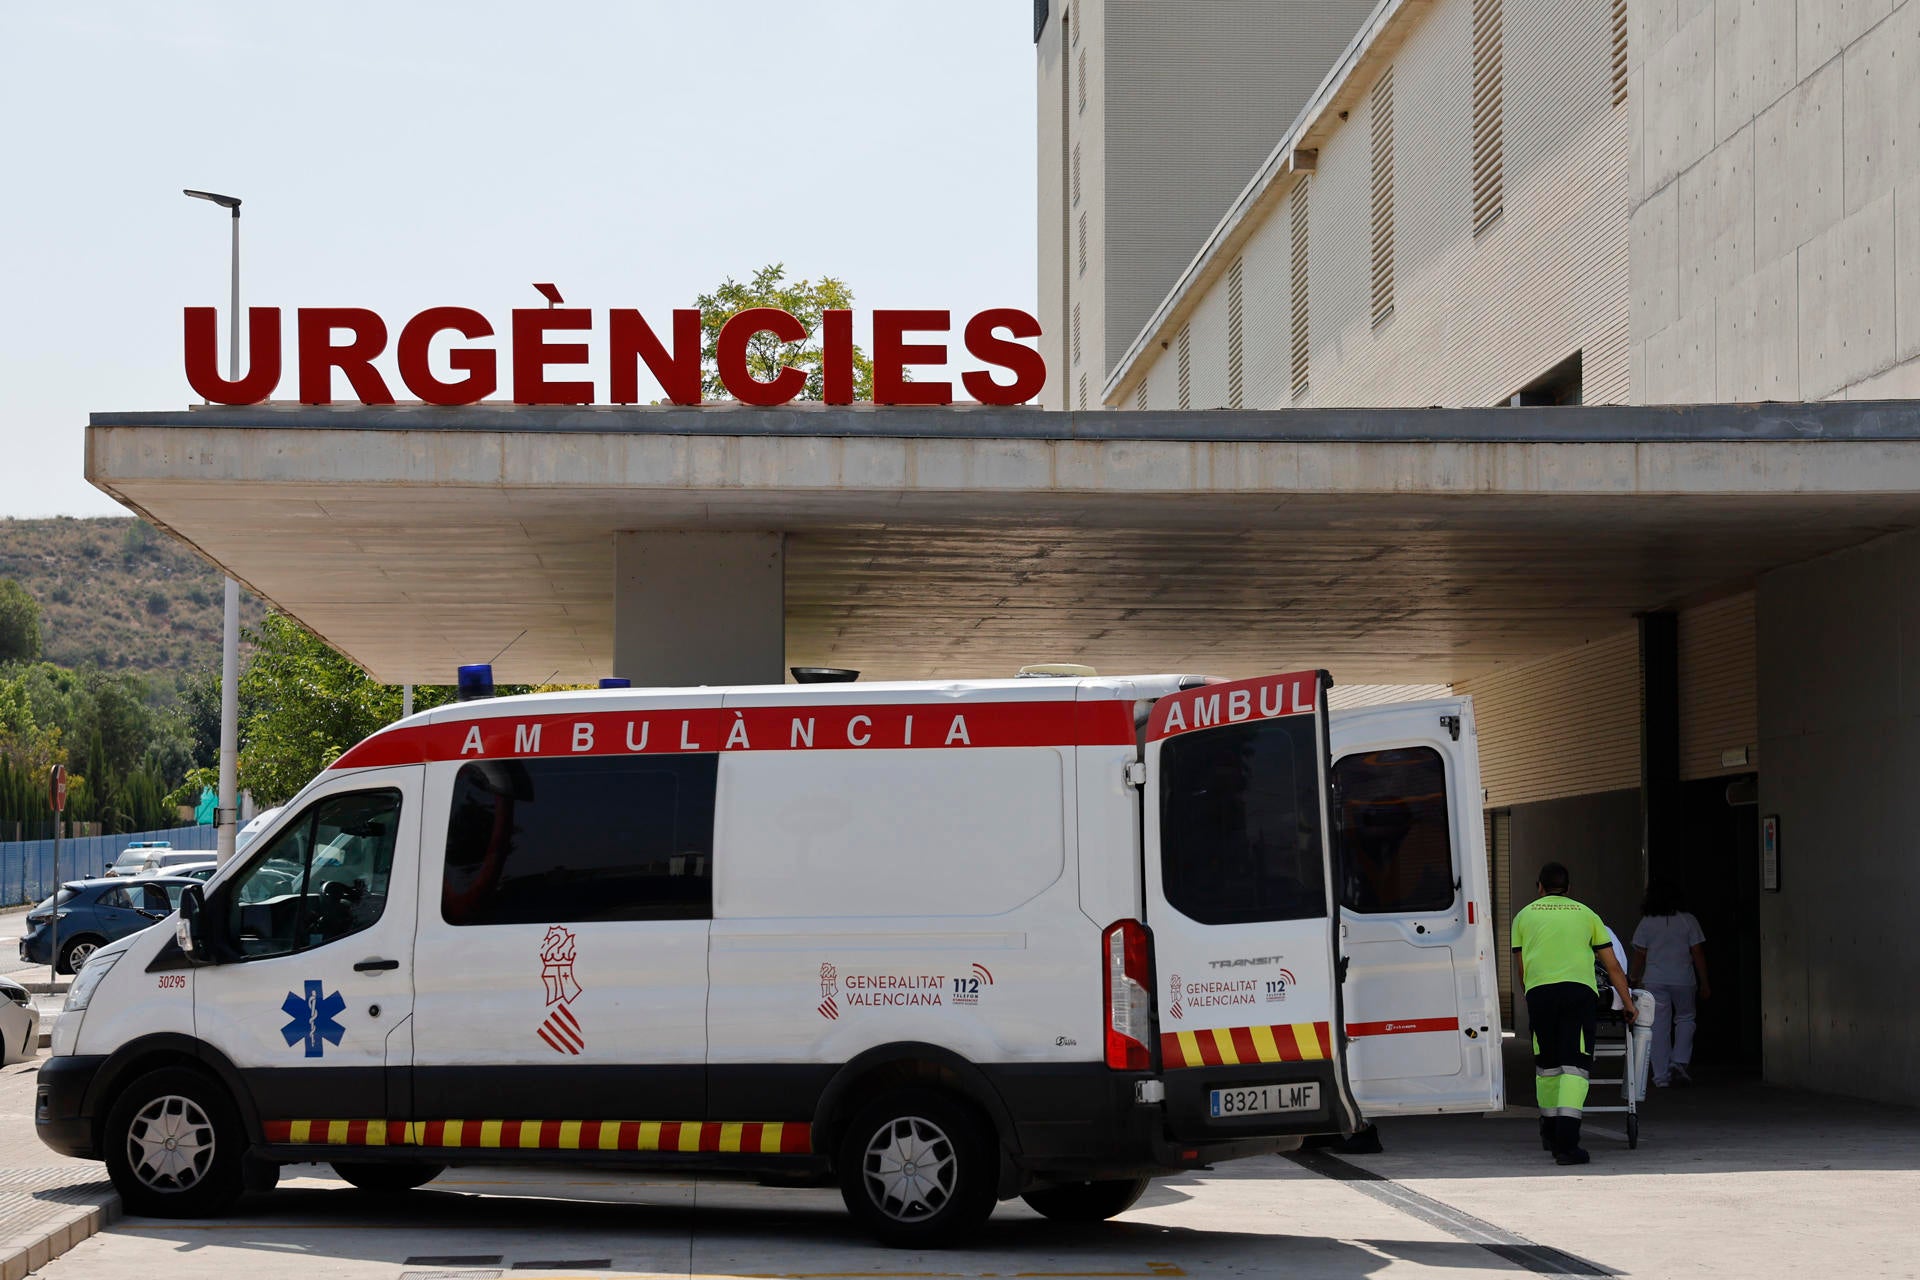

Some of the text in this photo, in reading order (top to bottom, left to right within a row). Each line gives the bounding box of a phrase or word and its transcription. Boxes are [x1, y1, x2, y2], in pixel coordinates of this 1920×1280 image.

[183, 283, 1047, 407] URGÈNCIES
[1163, 681, 1313, 734] AMBUL
[461, 711, 971, 755] AMBULÀNCIA
[1208, 955, 1284, 969] TRANSIT
[158, 975, 186, 989] 30295
[845, 975, 945, 990] GENERALITAT
[953, 978, 979, 993] 112
[1186, 979, 1258, 994] GENERALITAT
[1266, 980, 1286, 993] 112
[846, 992, 942, 1006] VALENCIANA
[1187, 994, 1256, 1008] VALENCIANA
[1224, 1085, 1314, 1113] 8321 LMF
